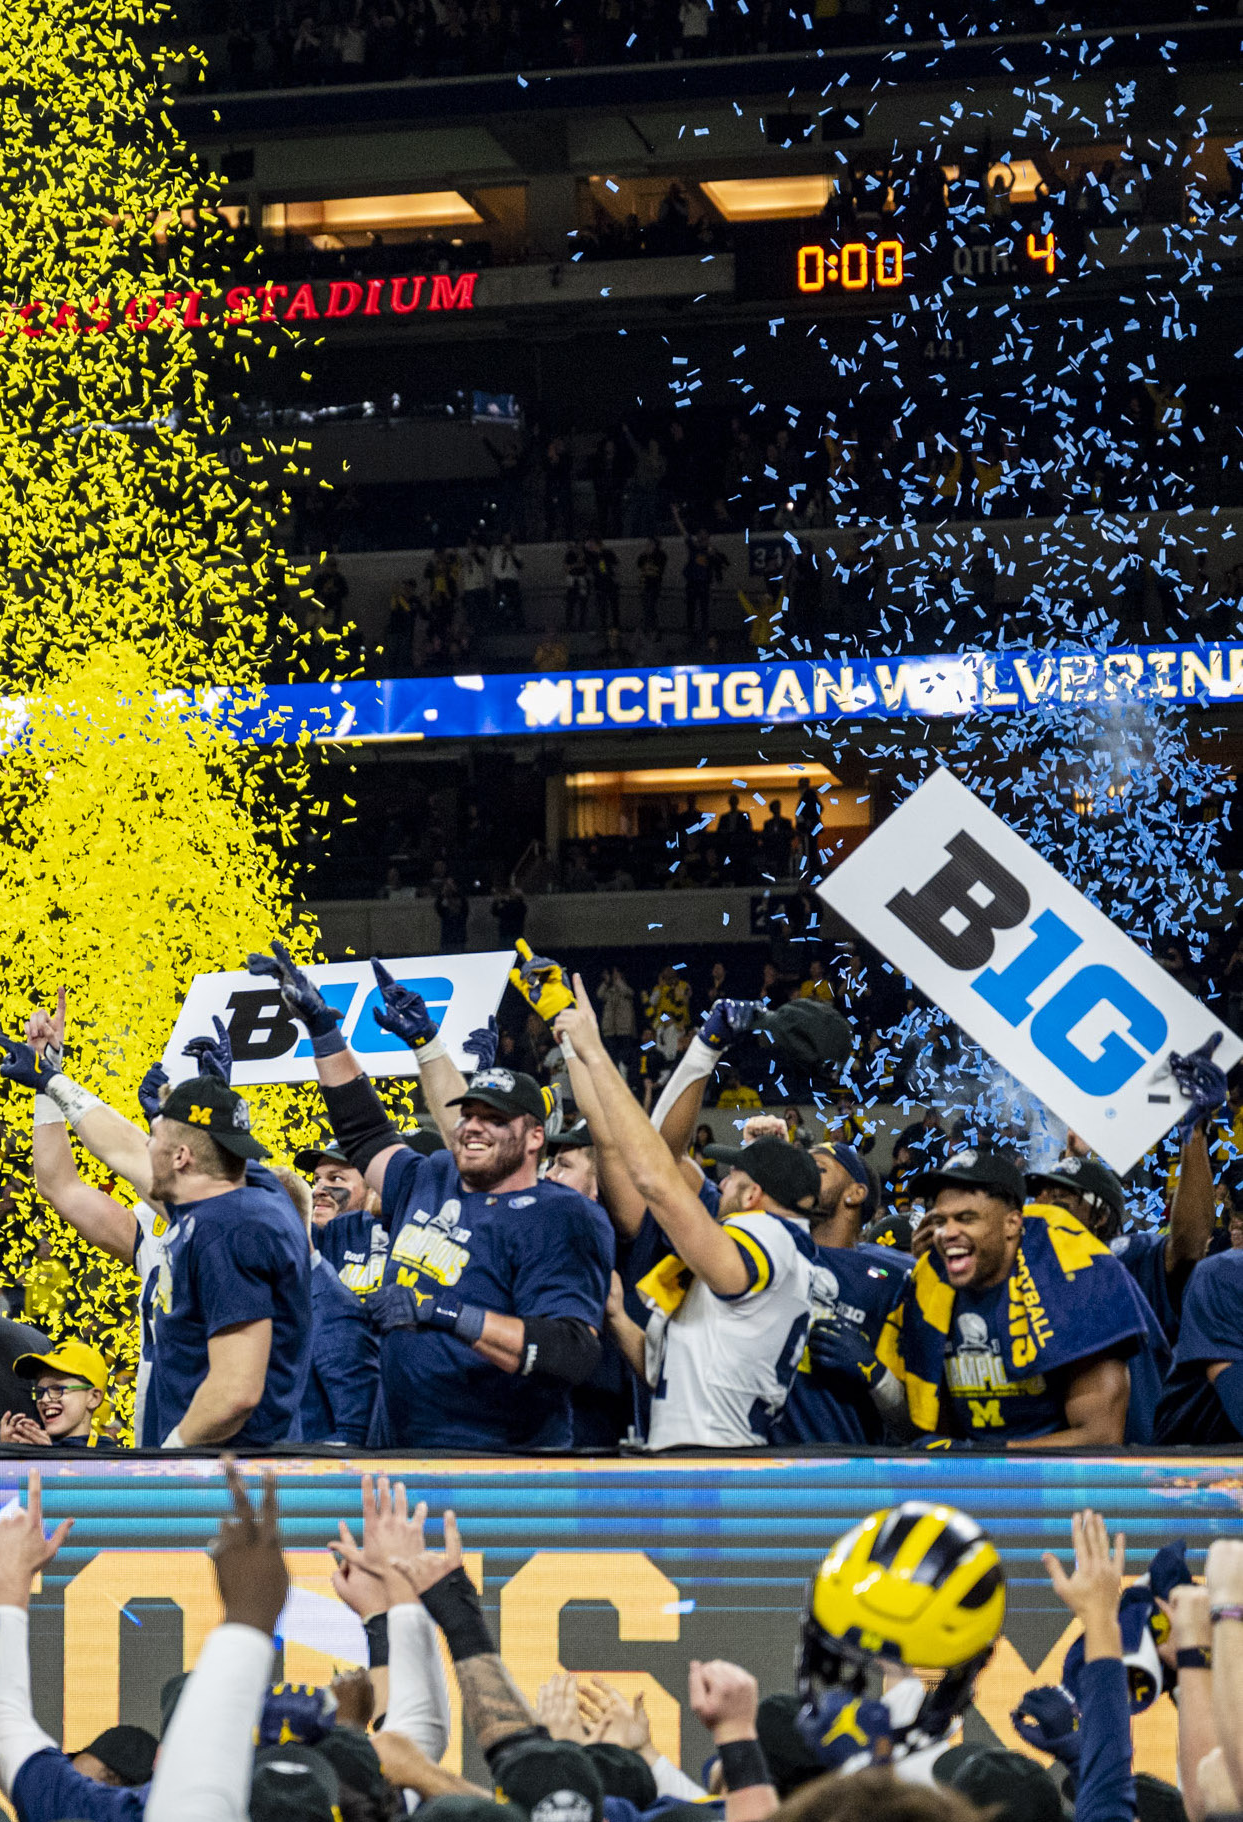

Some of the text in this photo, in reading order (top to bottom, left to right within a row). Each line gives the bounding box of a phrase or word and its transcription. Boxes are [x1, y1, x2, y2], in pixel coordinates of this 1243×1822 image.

[798, 241, 903, 291] 0:00
[1026, 232, 1055, 274] 4
[225, 272, 478, 323] STADIUM
[188, 1104, 214, 1126] M
[967, 1399, 1007, 1428] M
